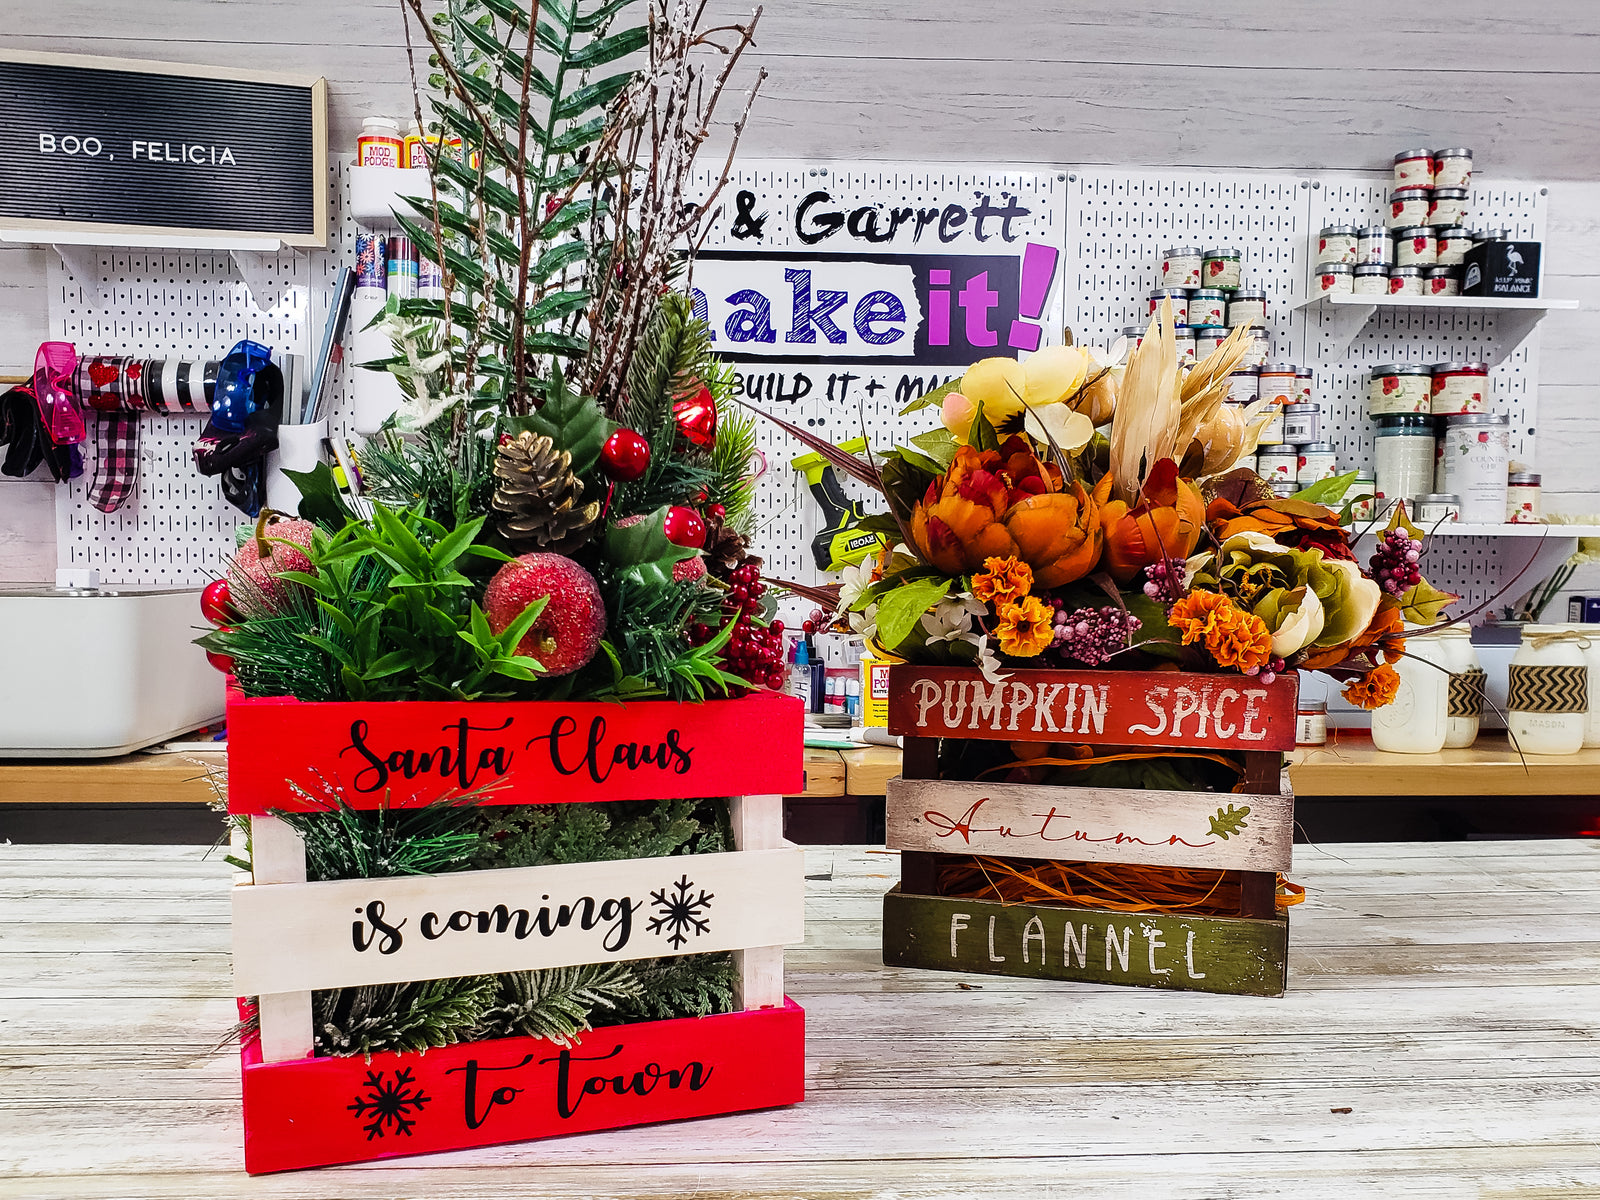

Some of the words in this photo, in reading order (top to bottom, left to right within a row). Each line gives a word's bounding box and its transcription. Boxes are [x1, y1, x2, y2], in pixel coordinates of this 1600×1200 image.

[38, 133, 116, 162] BOO,
[132, 140, 237, 166] FELICIA
[364, 156, 395, 168] PODGE
[369, 146, 391, 157] MOD
[730, 189, 771, 241] &
[794, 190, 1032, 246] Garrett
[692, 268, 906, 344] ake
[1495, 284, 1531, 293] BALANCE
[731, 372, 813, 404] BUILD
[826, 371, 861, 404] IT
[849, 534, 876, 549] RYOBI
[910, 678, 1109, 736] PUMPKIN
[1127, 684, 1269, 742] SPICE
[339, 716, 515, 794] Santa
[526, 715, 695, 784] Claus
[923, 797, 1217, 849] Autumn
[351, 899, 407, 956] is
[419, 893, 645, 953] coming
[949, 912, 1207, 981] FLANNEL
[445, 1053, 535, 1131] to
[538, 1044, 715, 1120] town
